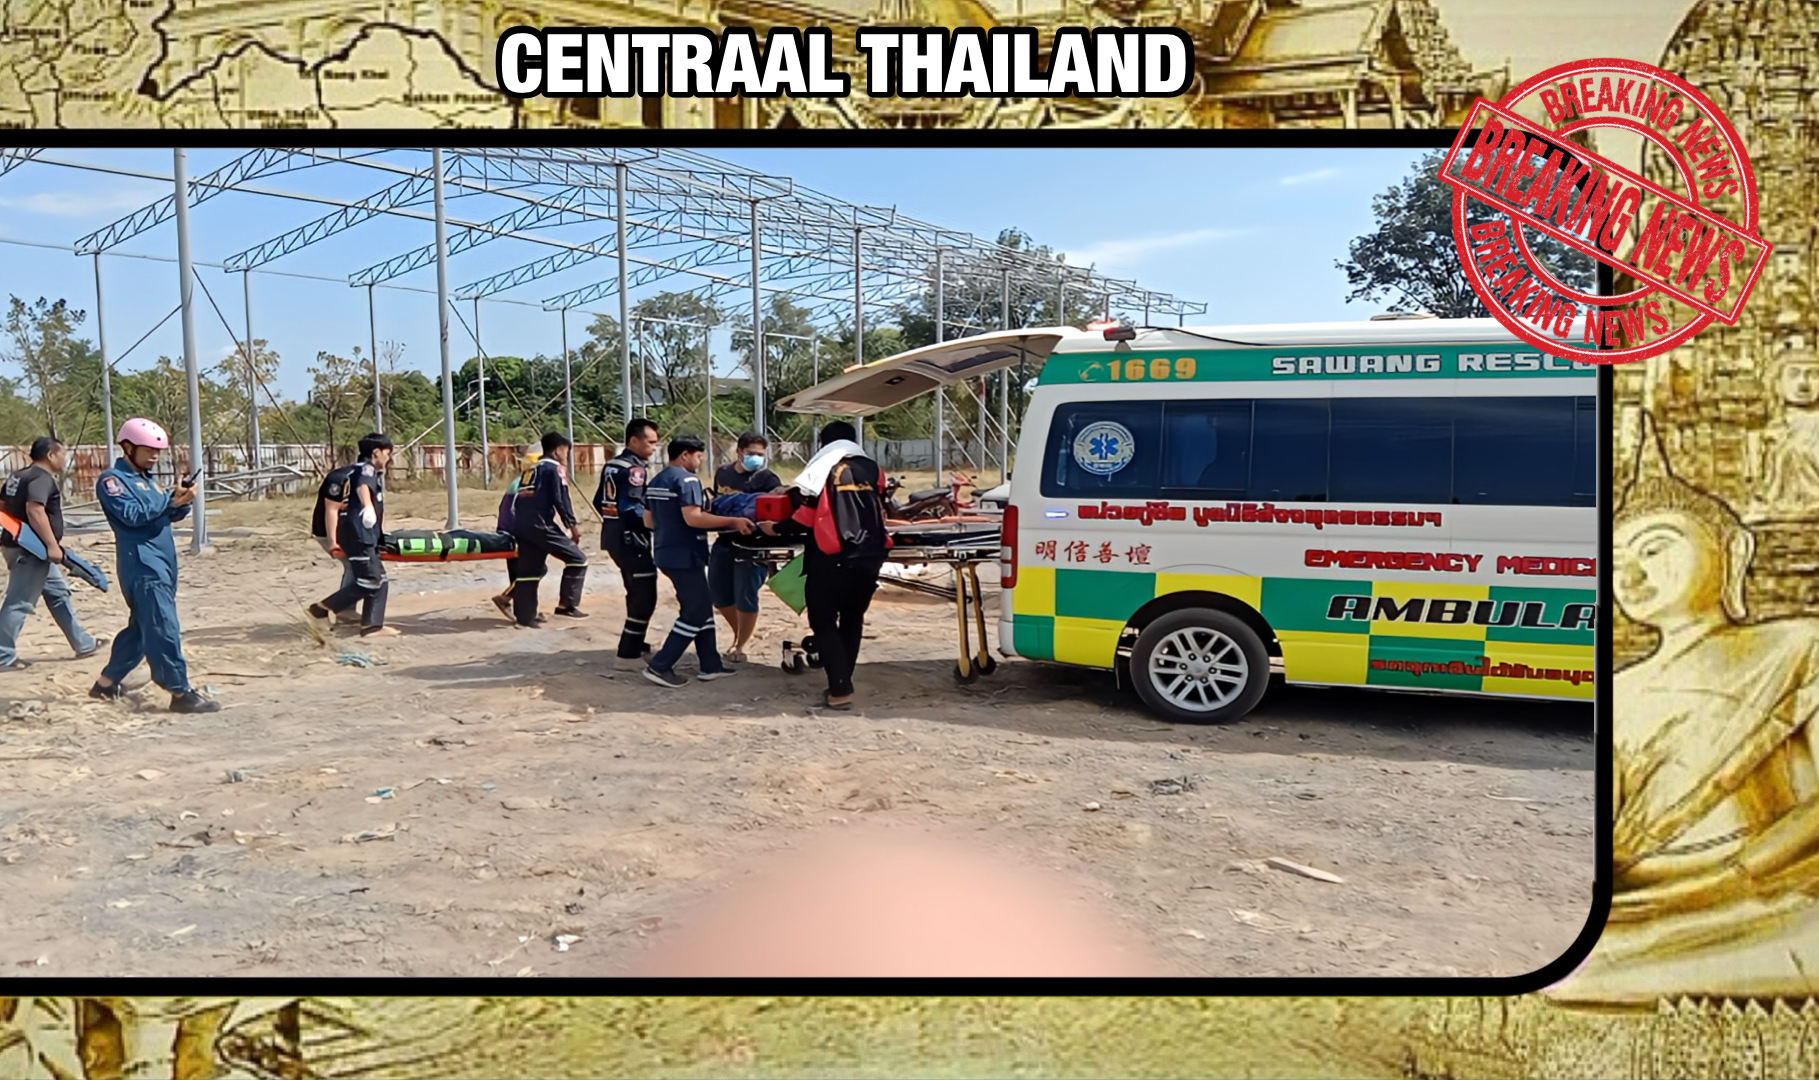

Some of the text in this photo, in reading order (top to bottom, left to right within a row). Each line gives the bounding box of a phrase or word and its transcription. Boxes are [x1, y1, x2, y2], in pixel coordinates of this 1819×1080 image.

[1107, 358, 1196, 381] 1669
[1271, 354, 1441, 375] SAWANG
[1035, 540, 1152, 565] 明信善壇
[1304, 549, 1596, 577] EMERGENCY MEDIC
[1326, 594, 1596, 630] AMBULA
